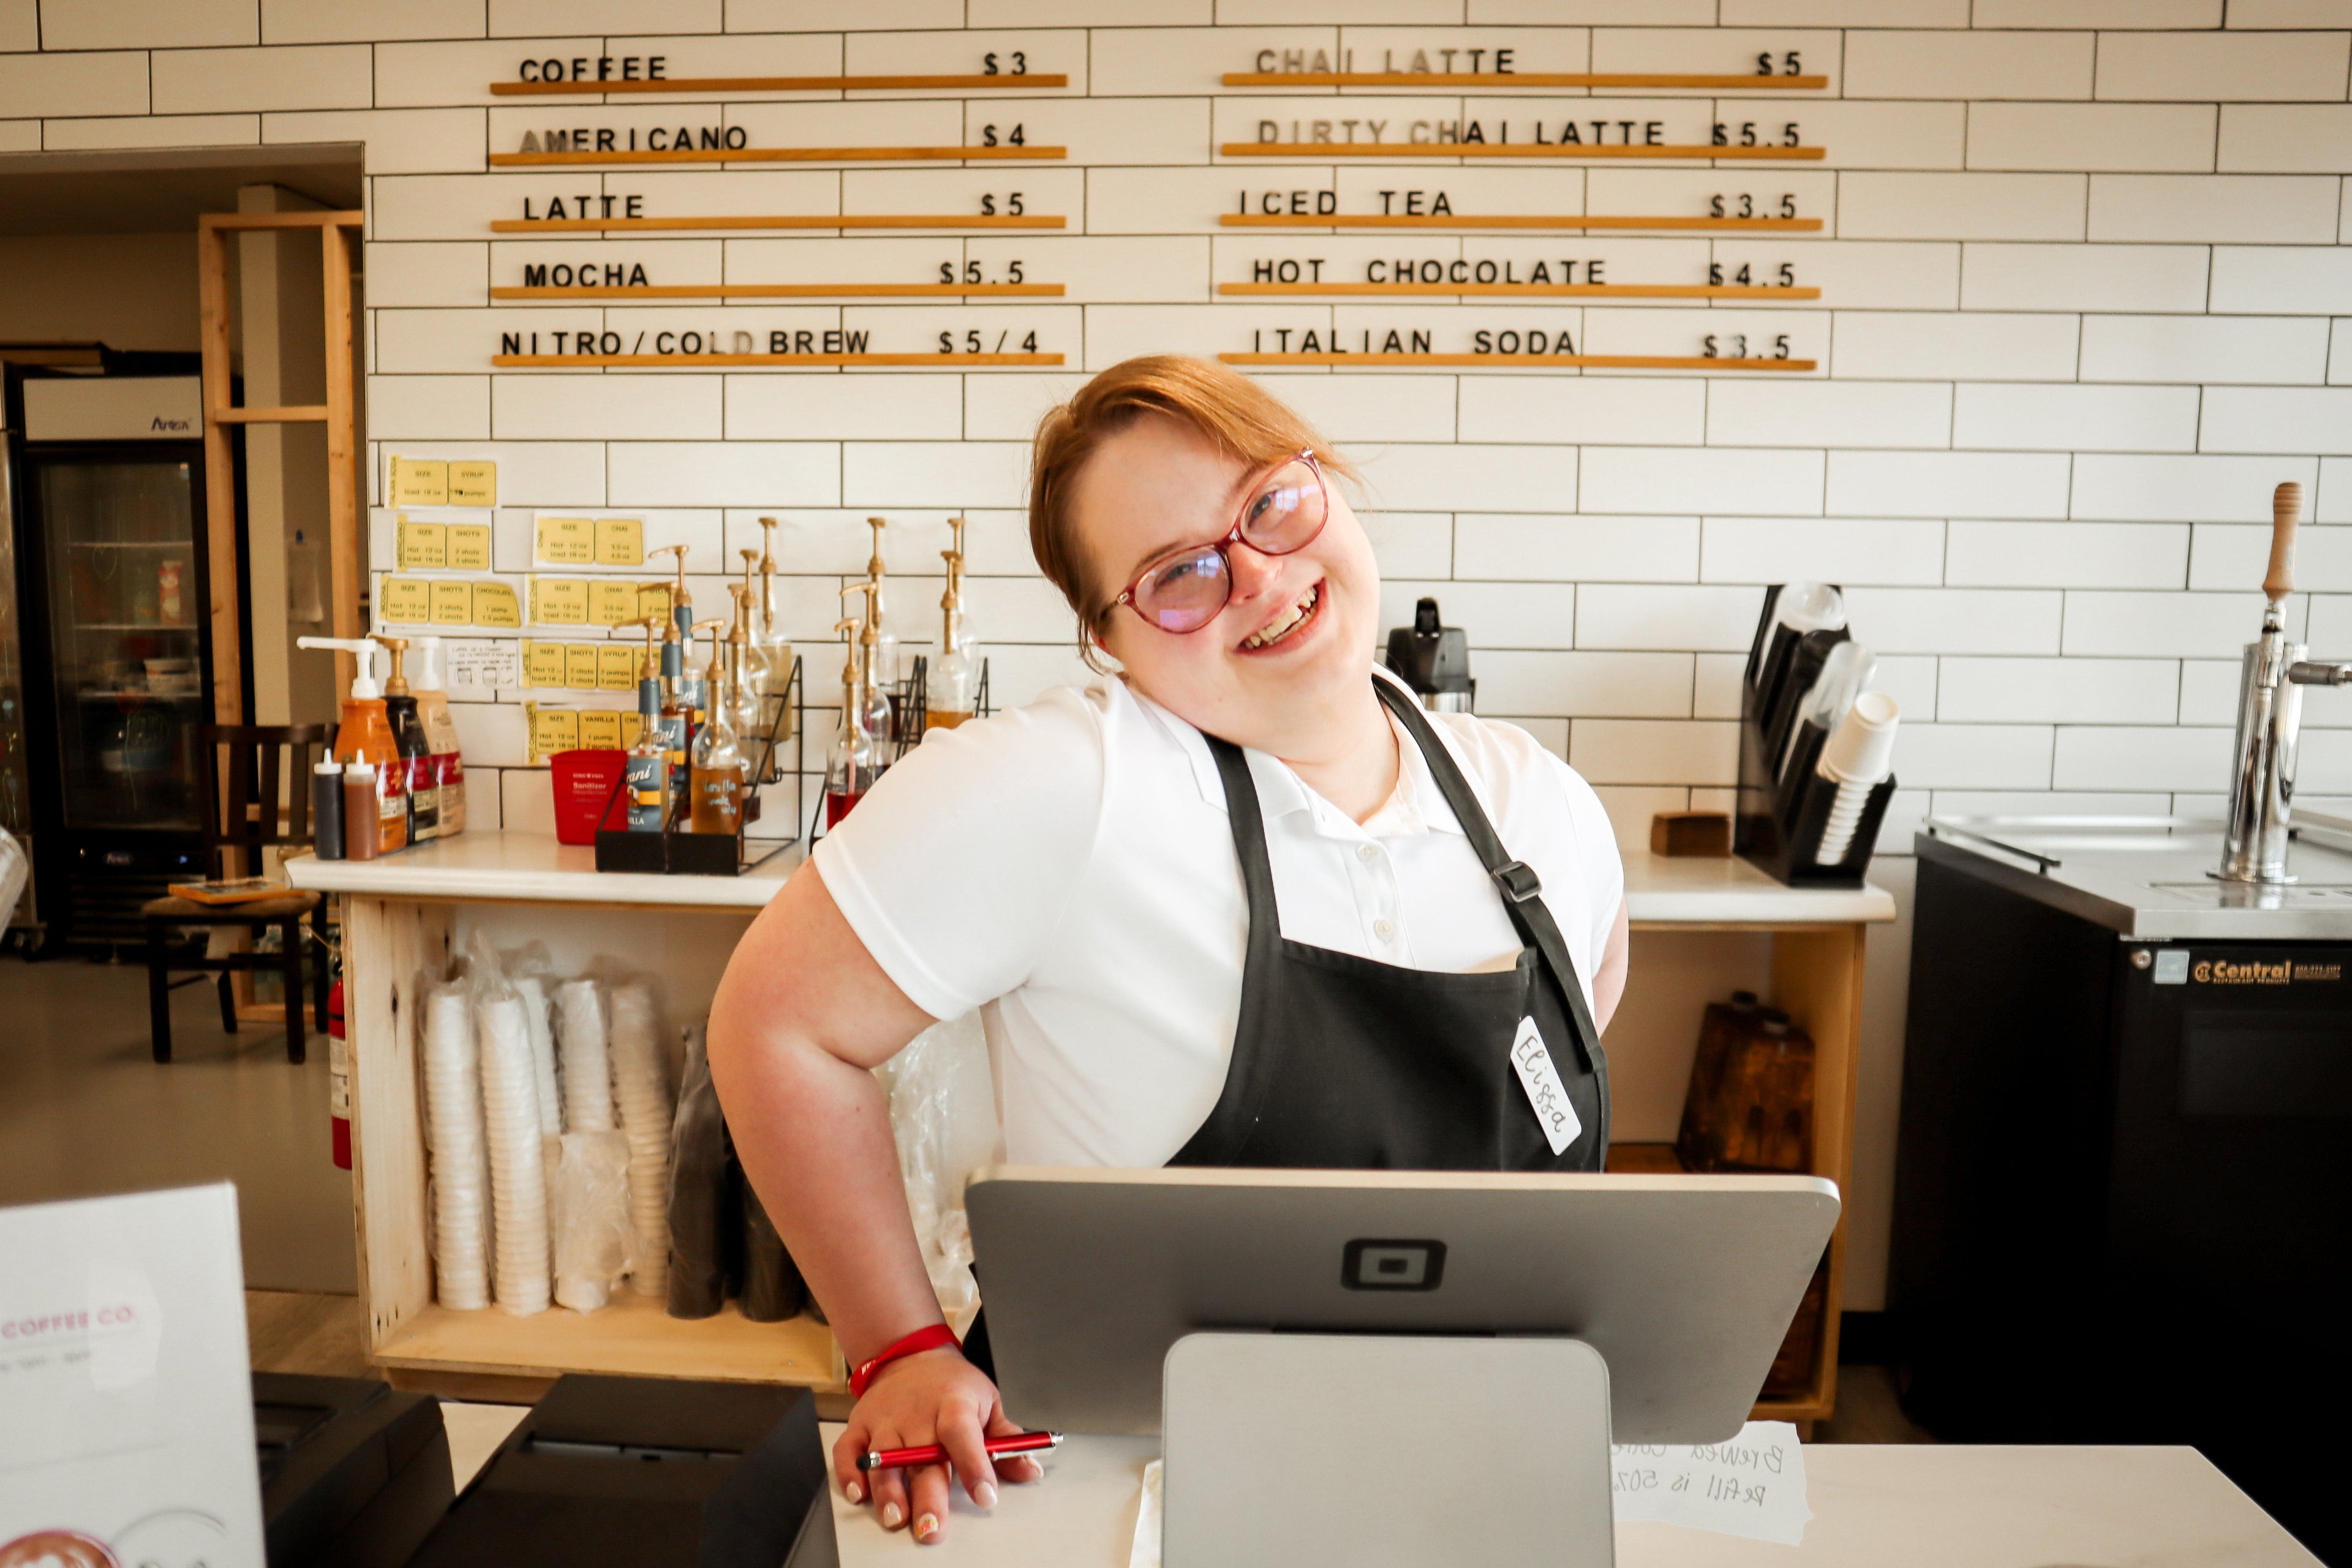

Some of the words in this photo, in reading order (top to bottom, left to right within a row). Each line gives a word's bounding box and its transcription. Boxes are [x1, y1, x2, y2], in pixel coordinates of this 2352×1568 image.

[520, 56, 666, 83] COFFEE
[983, 51, 1027, 76] $3
[1256, 49, 1354, 74] CHAI
[1384, 49, 1515, 75] LATTE
[1757, 51, 1801, 76] $5
[519, 125, 747, 154] AMERICANO
[983, 124, 1025, 148] $4
[1258, 119, 1389, 145] DIRTY
[1409, 119, 1509, 145] CHAI
[1536, 121, 1664, 146] LATTE
[1711, 122, 1800, 147] $5.5
[523, 195, 644, 221] LATTE
[981, 192, 1025, 217] $5
[1240, 190, 1337, 216] ICED
[1379, 190, 1453, 216] TEA
[1710, 194, 1796, 220] $3.5
[524, 263, 649, 288] MOCHA
[939, 260, 1024, 285] $5.5
[1253, 259, 1326, 284] HOT
[1366, 259, 1607, 286] CHOCOLATE
[1708, 263, 1795, 288] $4.5
[769, 331, 870, 355] BREW
[938, 330, 1038, 355] $5/4
[1255, 330, 1432, 355] ITALIAN
[1474, 330, 1575, 355] SODA
[2214, 960, 2292, 979] Central
[1517, 1035, 1566, 1133] Elissa
[1, 1310, 89, 1340] COFFEE
